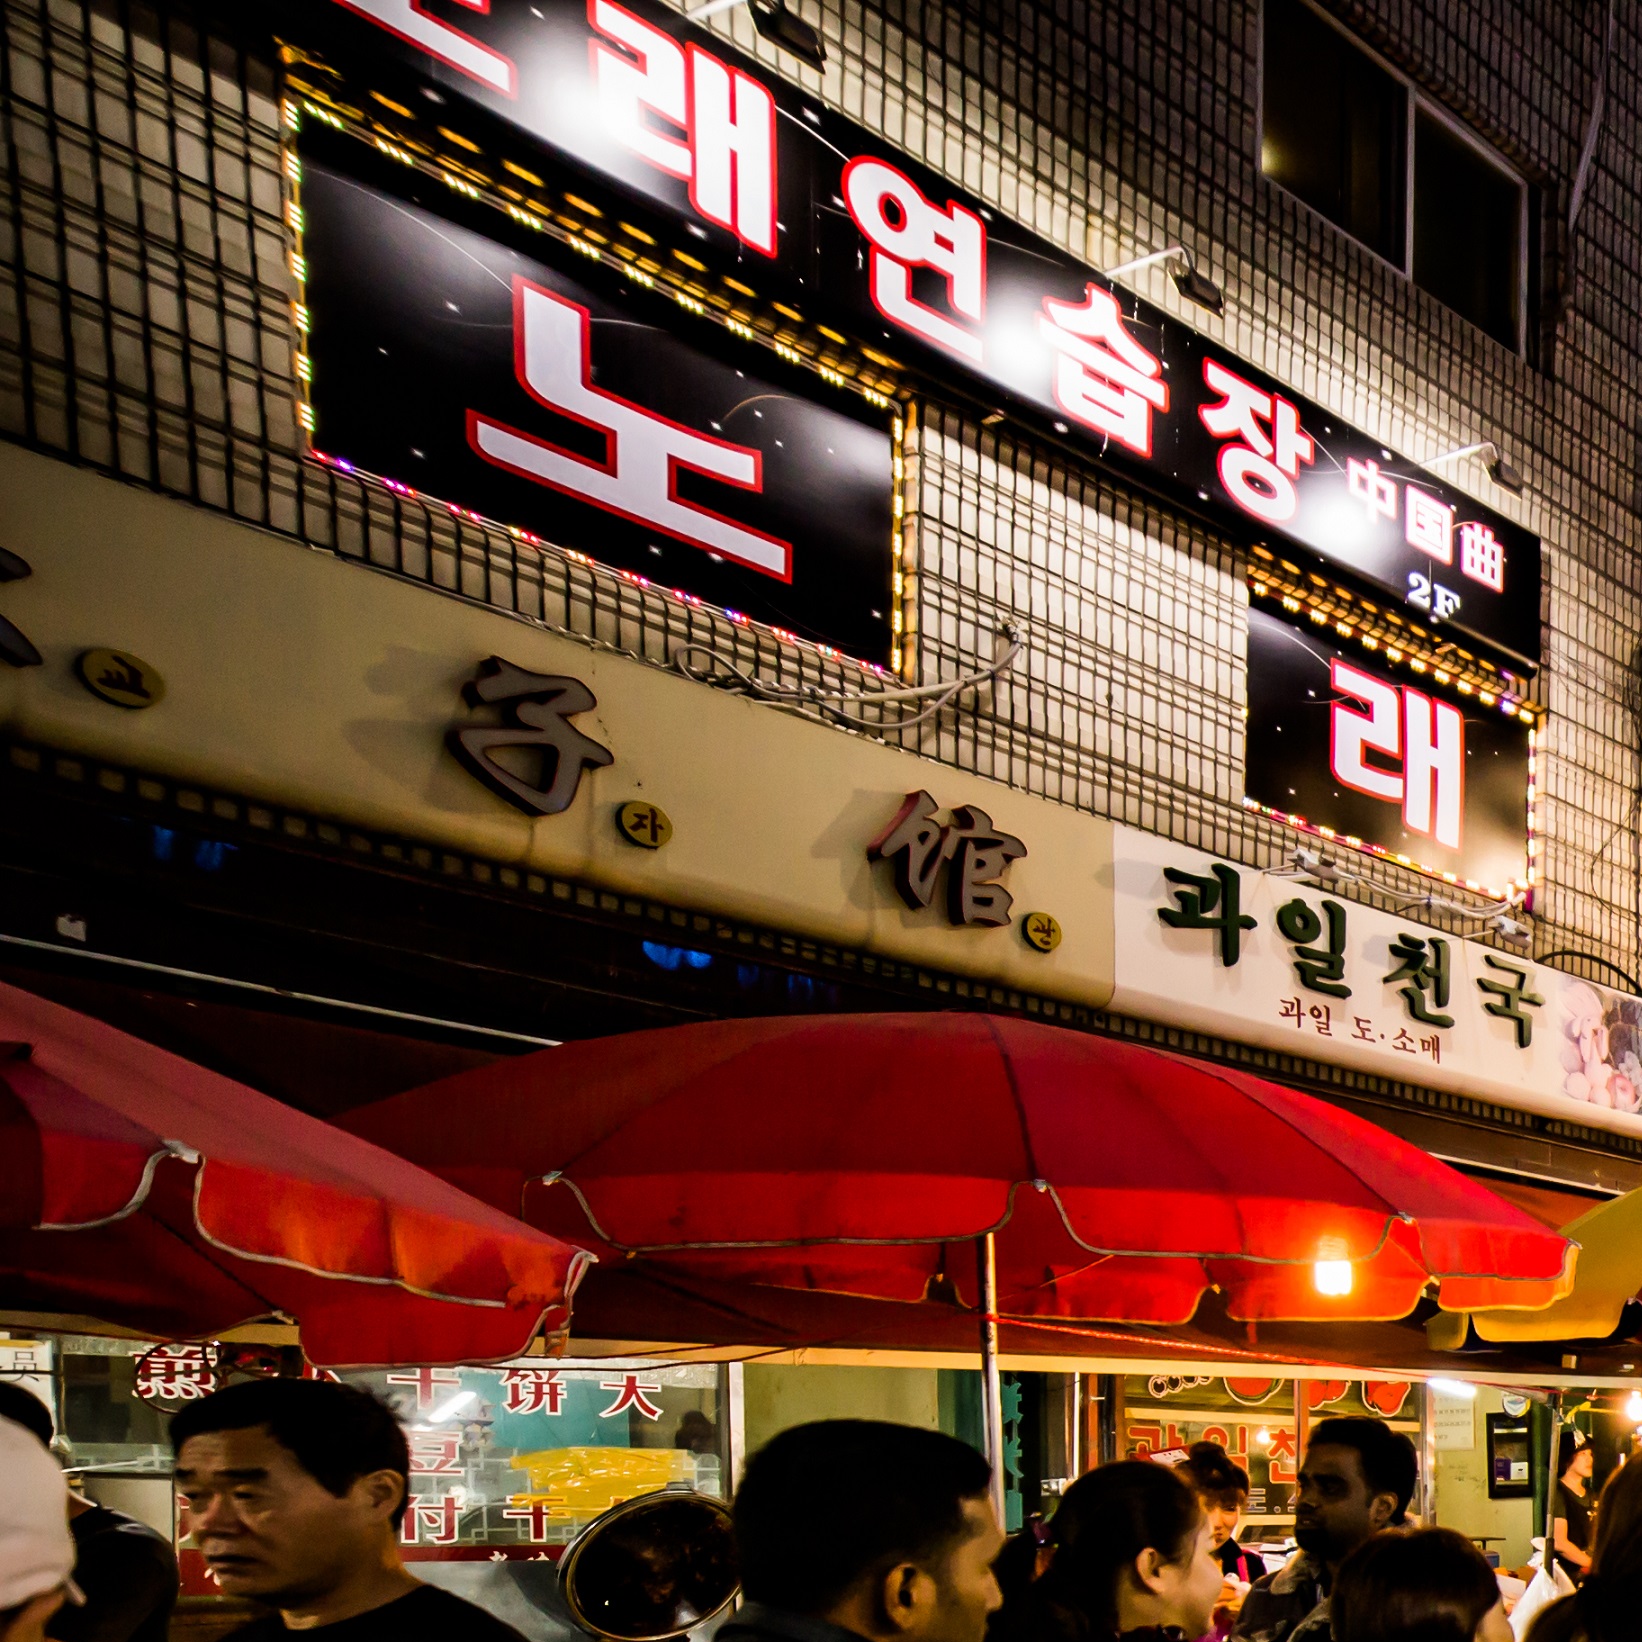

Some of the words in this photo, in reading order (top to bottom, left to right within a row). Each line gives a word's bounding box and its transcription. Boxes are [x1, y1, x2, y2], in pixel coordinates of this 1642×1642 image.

[334, 0, 1315, 521] 래연습장
[465, 274, 793, 585] 노
[1347, 457, 1504, 593] 中国曲
[1406, 572, 1461, 620] 2F
[629, 808, 664, 842] 자
[1330, 657, 1464, 856] 래
[1157, 862, 1546, 1049] 과일천국
[1279, 996, 1334, 1038] 과일
